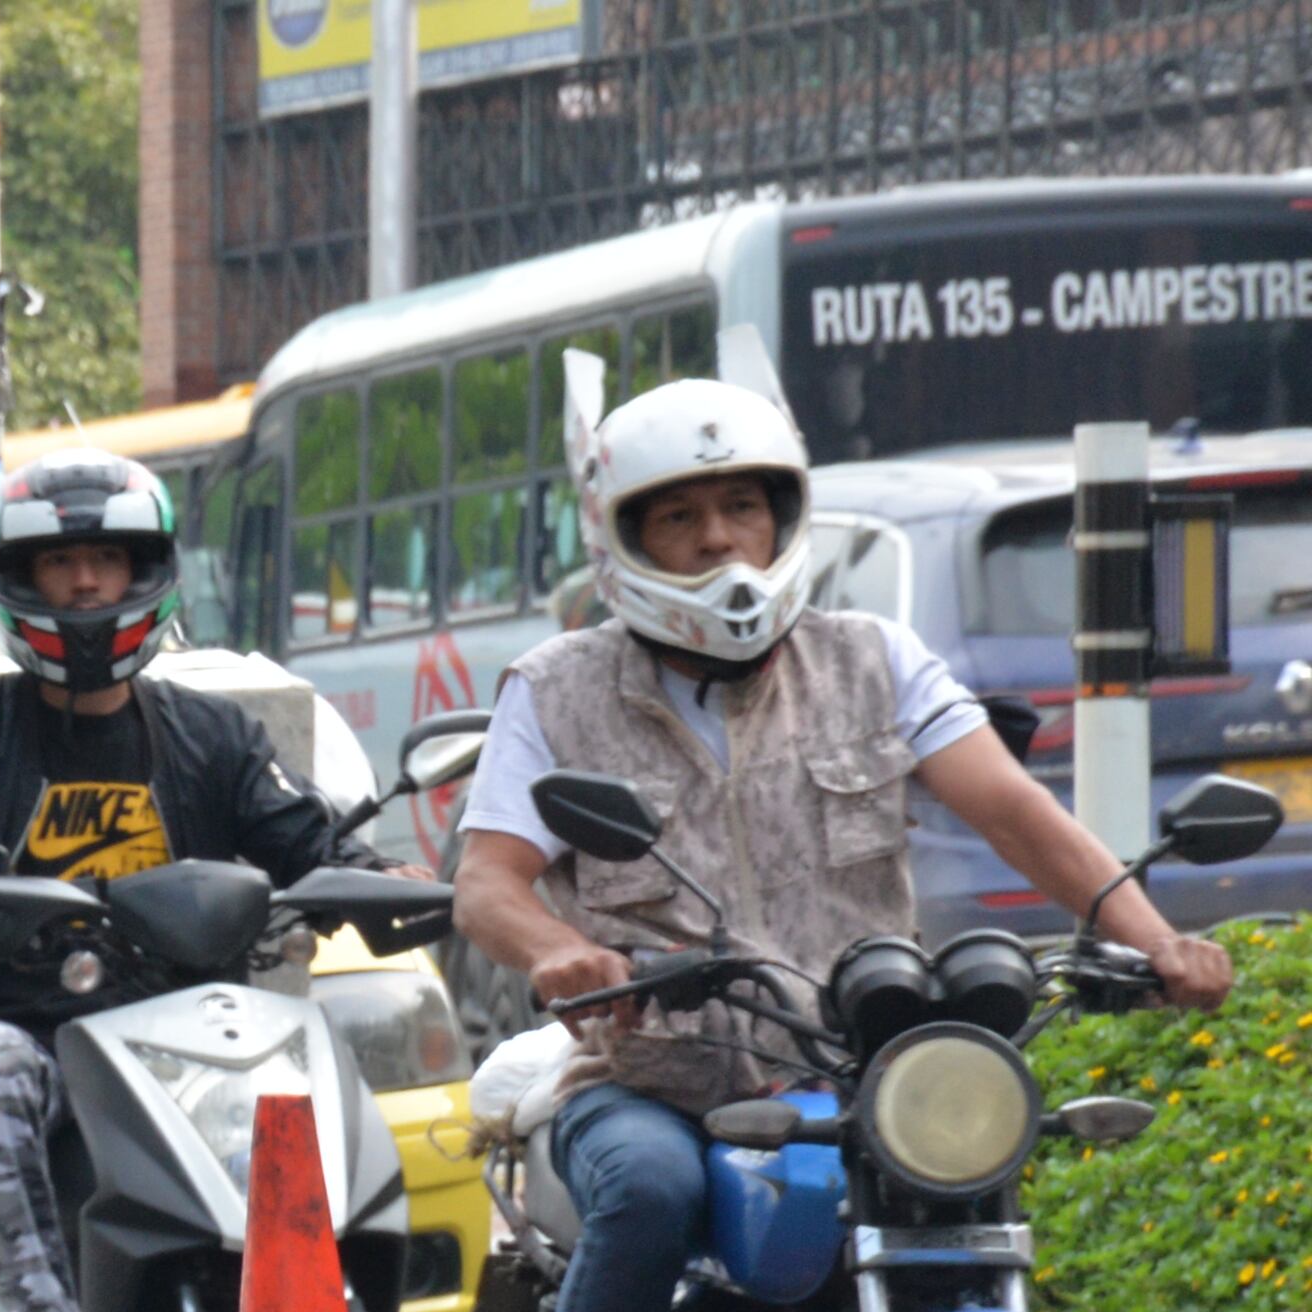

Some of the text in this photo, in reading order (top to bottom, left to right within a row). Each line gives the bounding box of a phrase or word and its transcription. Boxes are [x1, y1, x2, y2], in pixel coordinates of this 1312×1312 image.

[812, 282, 932, 347] RUTA
[938, 277, 1014, 338] 135
[1051, 259, 1312, 332] CAMPESTRE
[38, 786, 142, 841] NIKE
